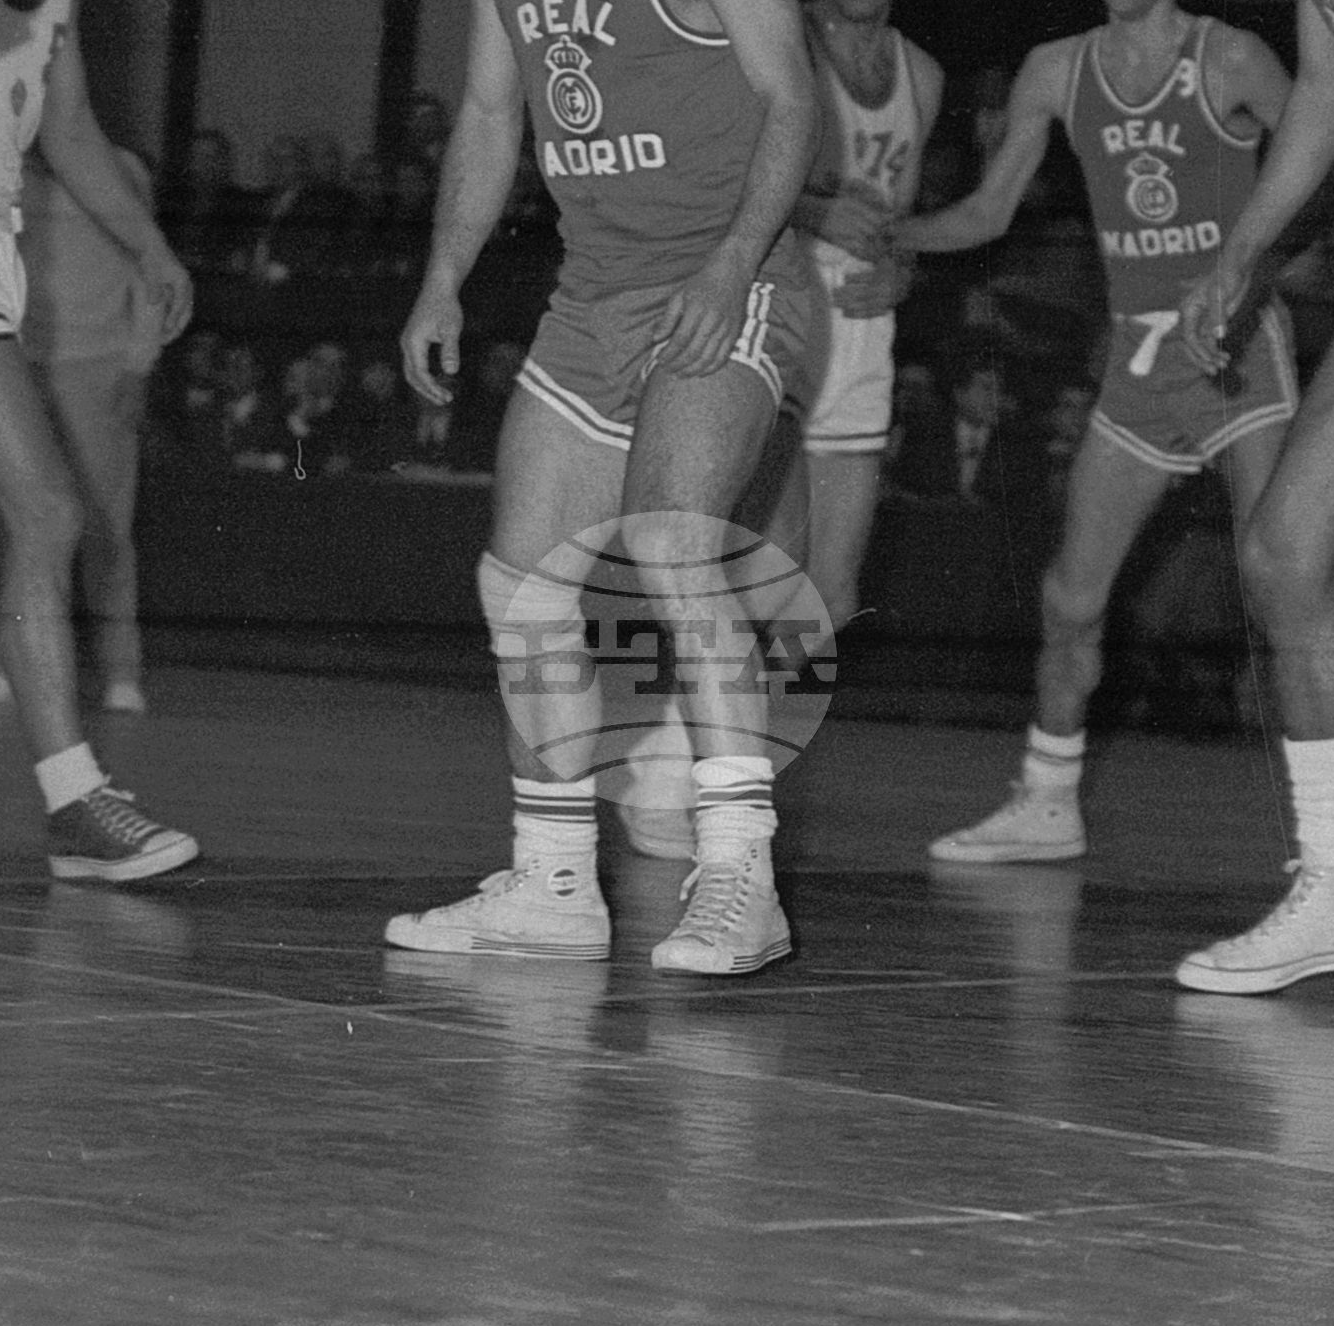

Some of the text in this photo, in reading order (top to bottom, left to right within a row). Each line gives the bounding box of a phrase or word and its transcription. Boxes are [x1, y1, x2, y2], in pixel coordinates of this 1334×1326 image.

[544, 133, 666, 177] ADRID
[1102, 119, 1185, 154] REAL
[1129, 310, 1180, 375] 7
